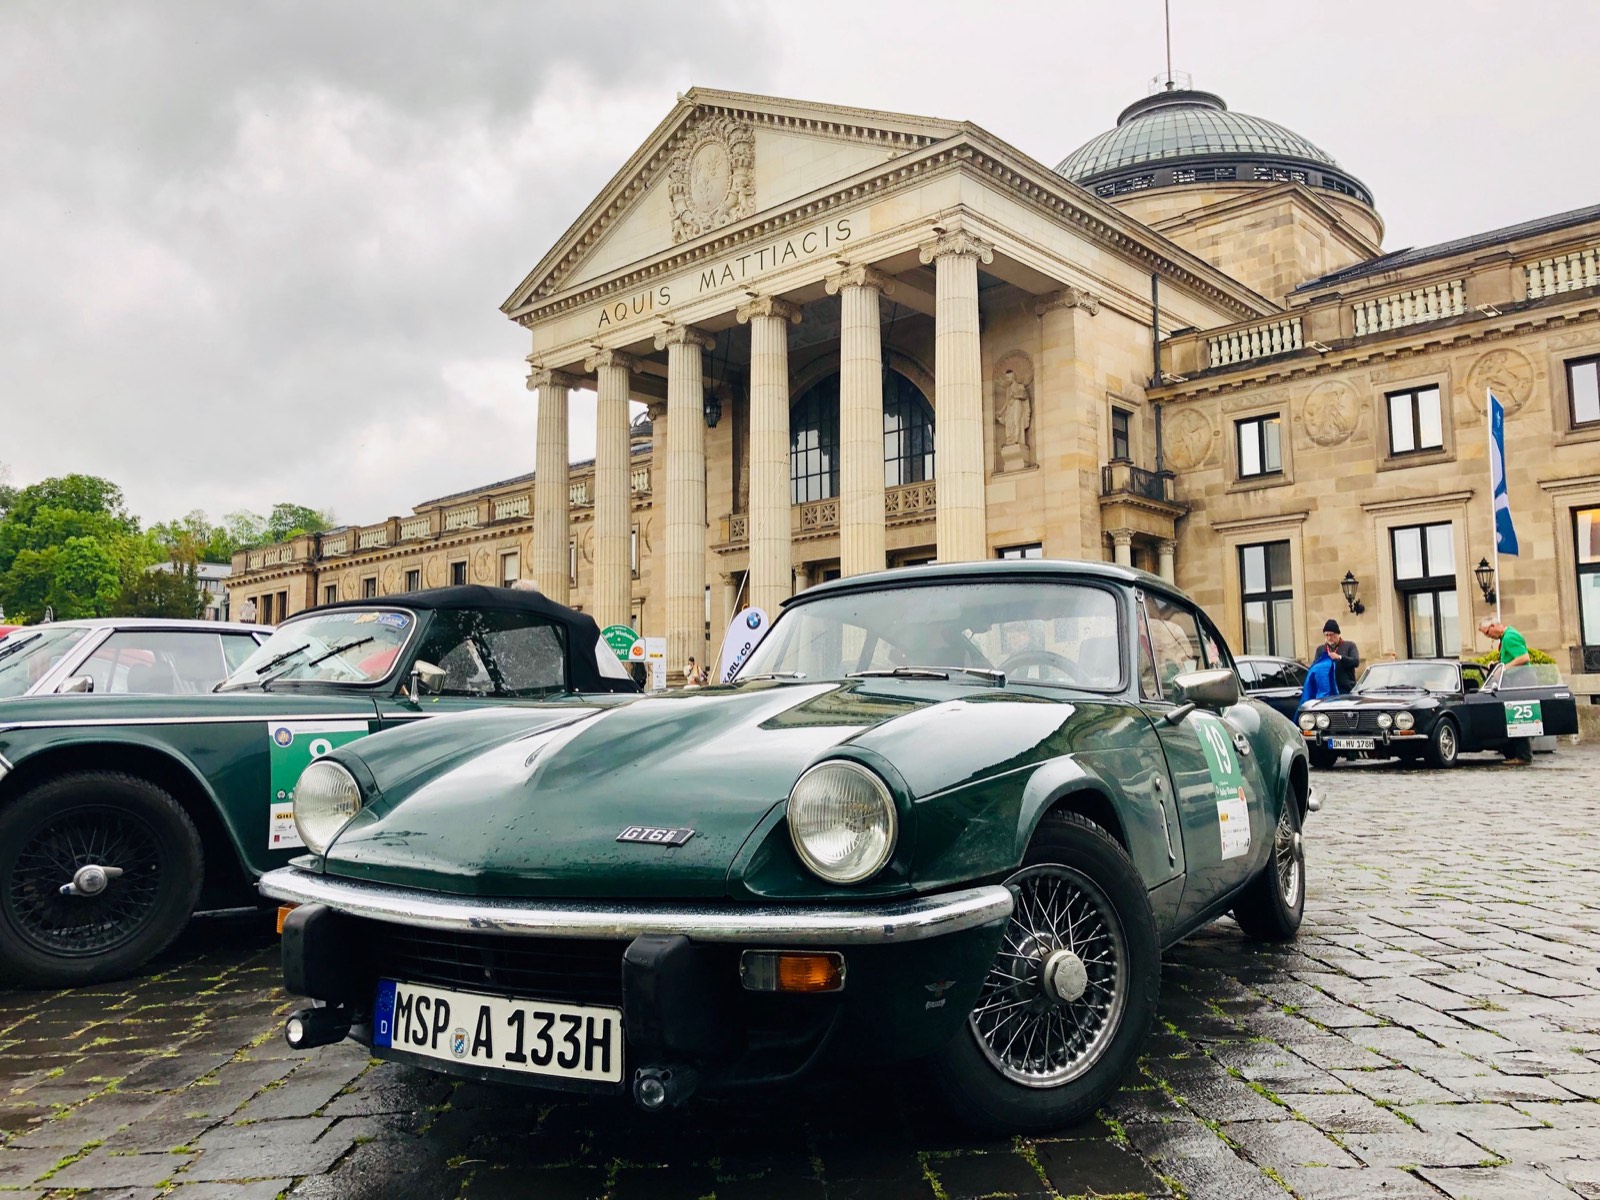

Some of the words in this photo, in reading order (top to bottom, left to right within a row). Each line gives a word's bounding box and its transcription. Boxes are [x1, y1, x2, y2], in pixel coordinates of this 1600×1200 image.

[598, 286, 671, 328] AQUIS
[699, 219, 851, 292] MATTIACIS
[1513, 705, 1533, 719] 25
[1204, 724, 1232, 774] 19
[380, 1020, 388, 1034] D
[393, 991, 450, 1049] MSP
[472, 1005, 494, 1059] A
[505, 1009, 611, 1073] 133H
